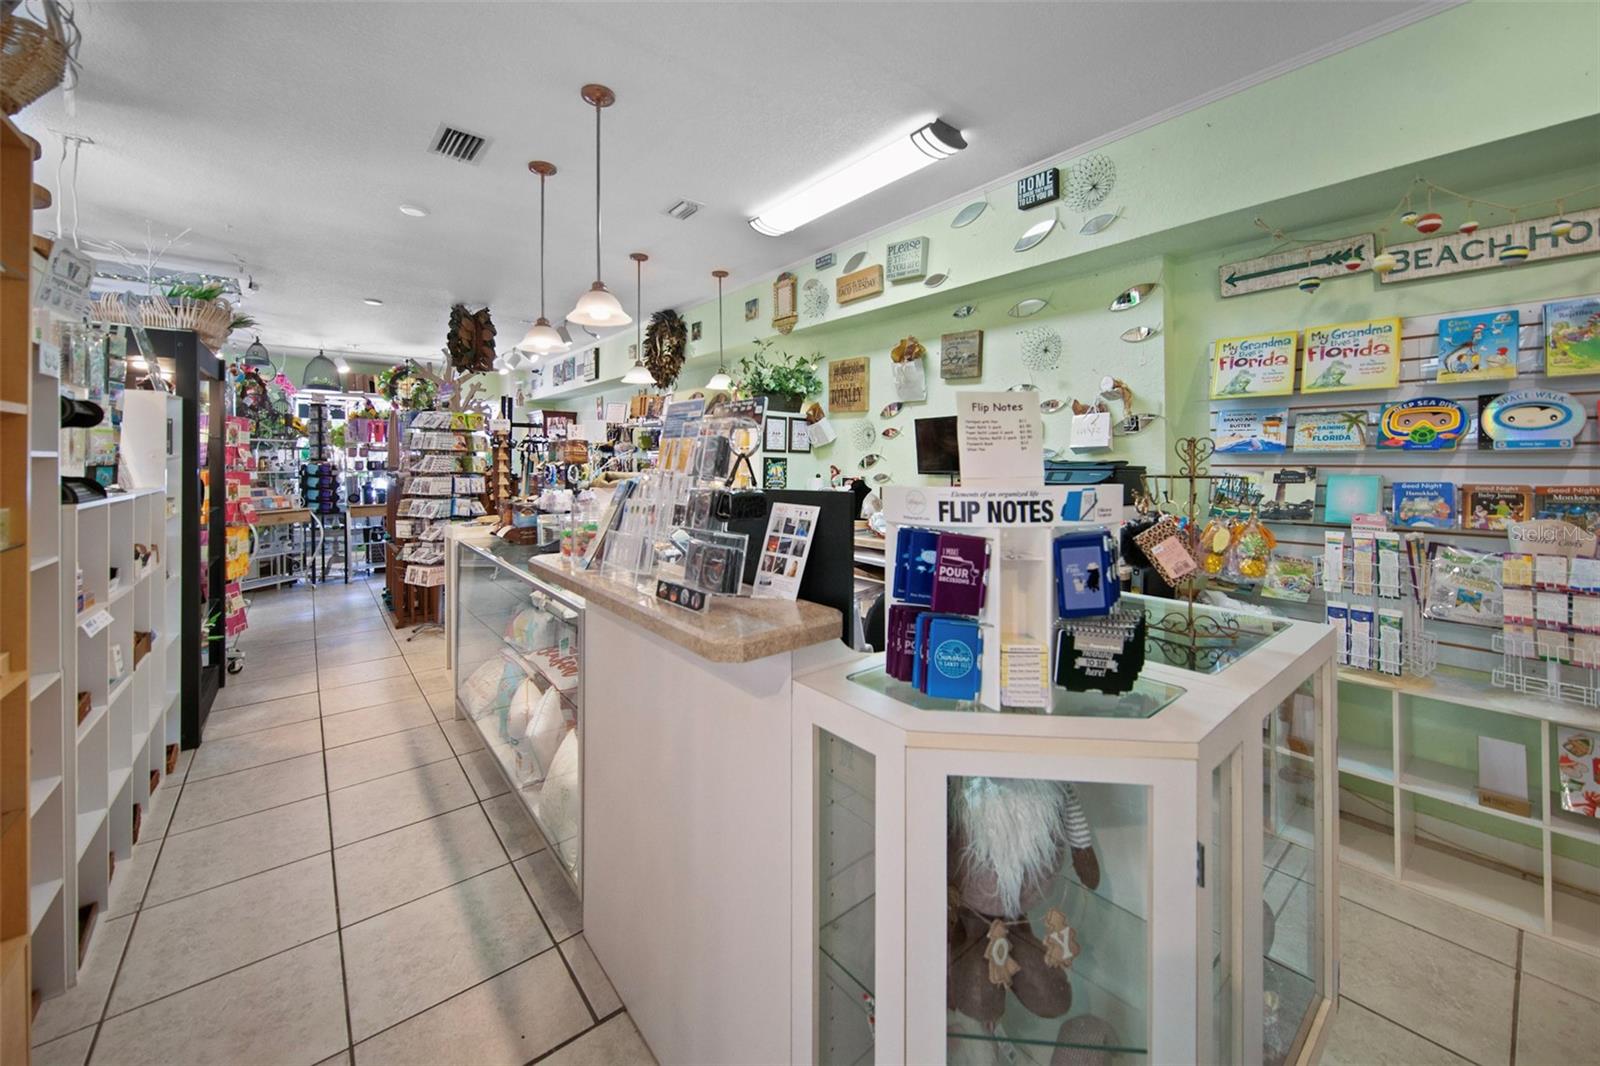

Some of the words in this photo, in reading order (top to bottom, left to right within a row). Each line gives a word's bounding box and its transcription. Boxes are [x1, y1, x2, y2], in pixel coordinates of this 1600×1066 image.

[1019, 170, 1053, 195] HOME
[1388, 233, 1514, 275] BEACH
[1528, 214, 1600, 252] HO
[1311, 331, 1329, 345] My
[1331, 323, 1393, 340] Grandma
[1222, 342, 1239, 356] My
[1239, 336, 1292, 351] Grandma
[1330, 339, 1351, 347] Lives
[1306, 338, 1392, 363] Florida
[1218, 354, 1289, 371] Florida
[1498, 391, 1529, 406] SPACE
[1535, 391, 1567, 403] WALK
[971, 402, 990, 414] Flip
[992, 402, 1023, 412] Notes
[1393, 402, 1414, 414] DEEP
[1439, 400, 1460, 409] DIVE
[1312, 434, 1351, 442] FLORIDA
[980, 490, 988, 500] of
[998, 491, 1029, 500] organized
[1029, 490, 1040, 498] life
[1478, 492, 1495, 500] Baby
[1573, 487, 1600, 495] Night
[1552, 494, 1596, 503] Monkeys
[938, 500, 981, 523] FLIP
[987, 499, 1054, 523] NOTES
[939, 566, 969, 579] POUR
[938, 577, 970, 585] DECISIONS
[936, 651, 971, 662] Sunshine
